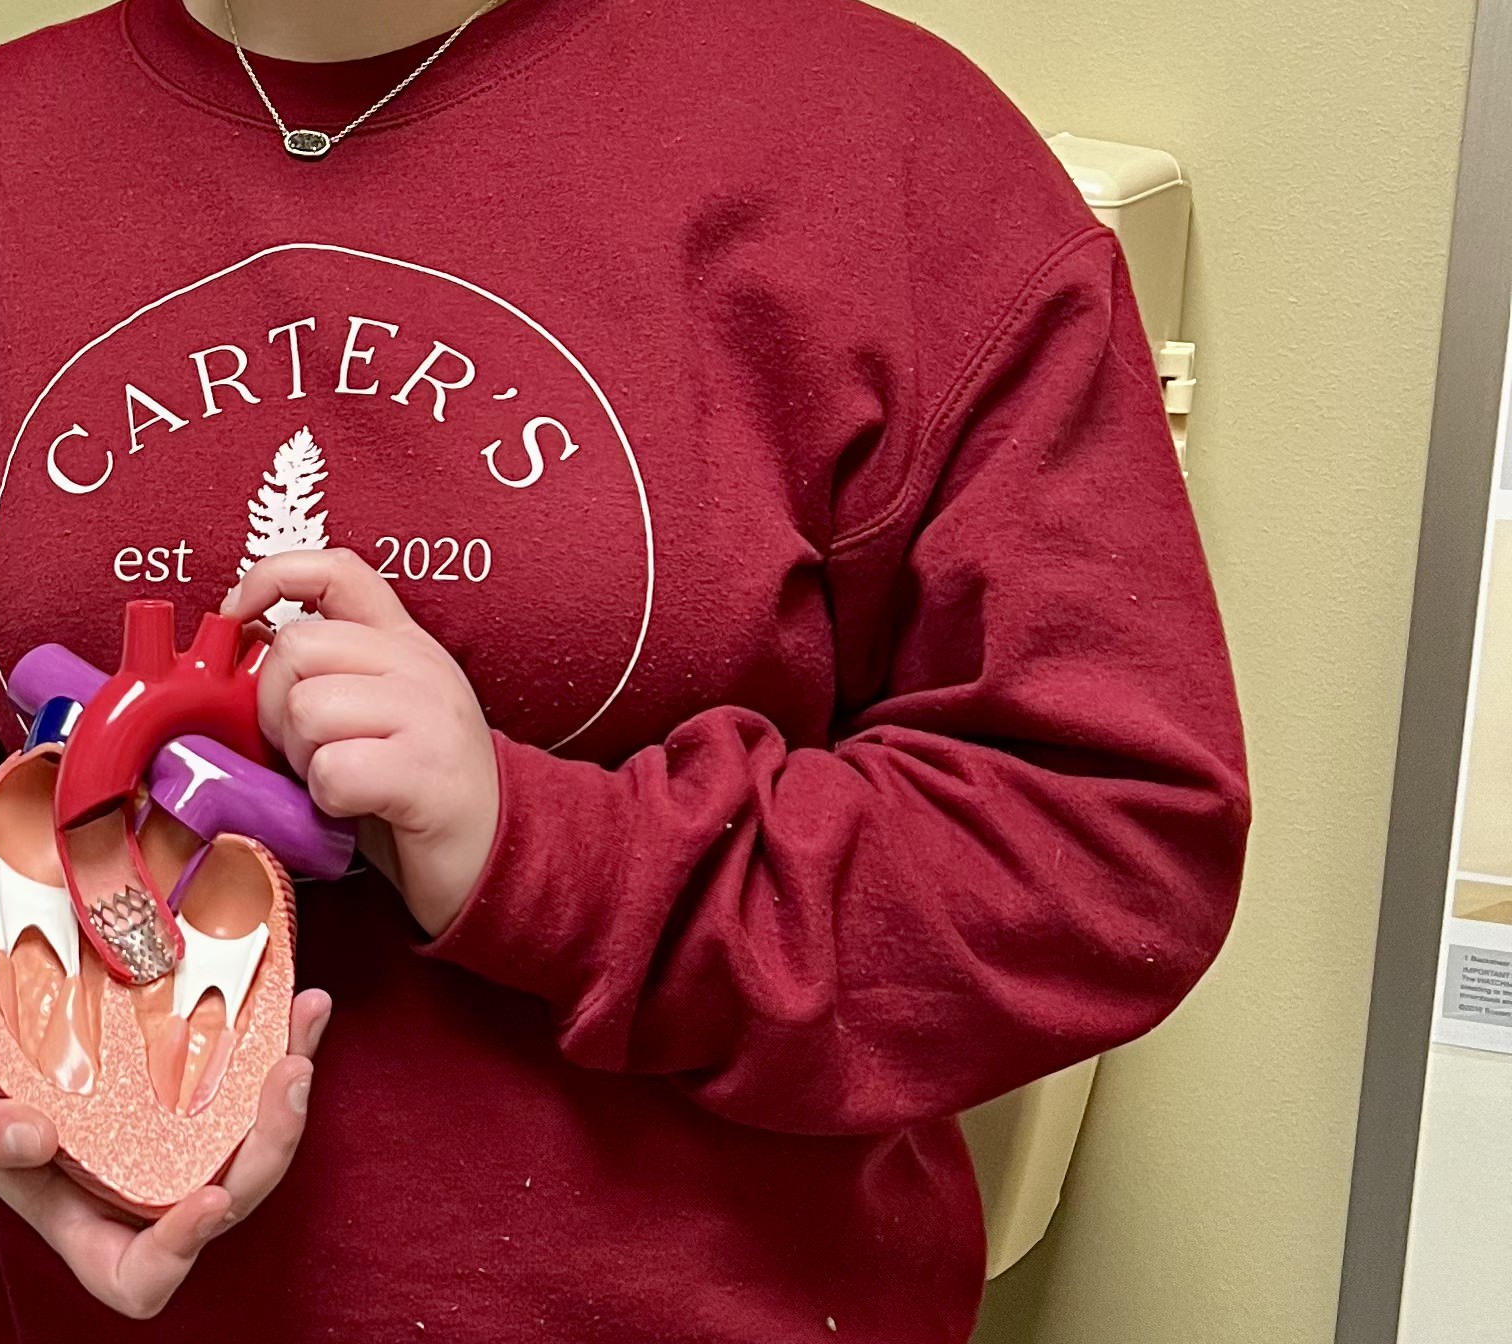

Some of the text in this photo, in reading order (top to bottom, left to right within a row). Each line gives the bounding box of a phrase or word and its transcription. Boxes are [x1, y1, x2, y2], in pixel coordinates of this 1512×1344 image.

[45, 314, 580, 495] CARTER'S
[112, 536, 493, 584] est 2020
